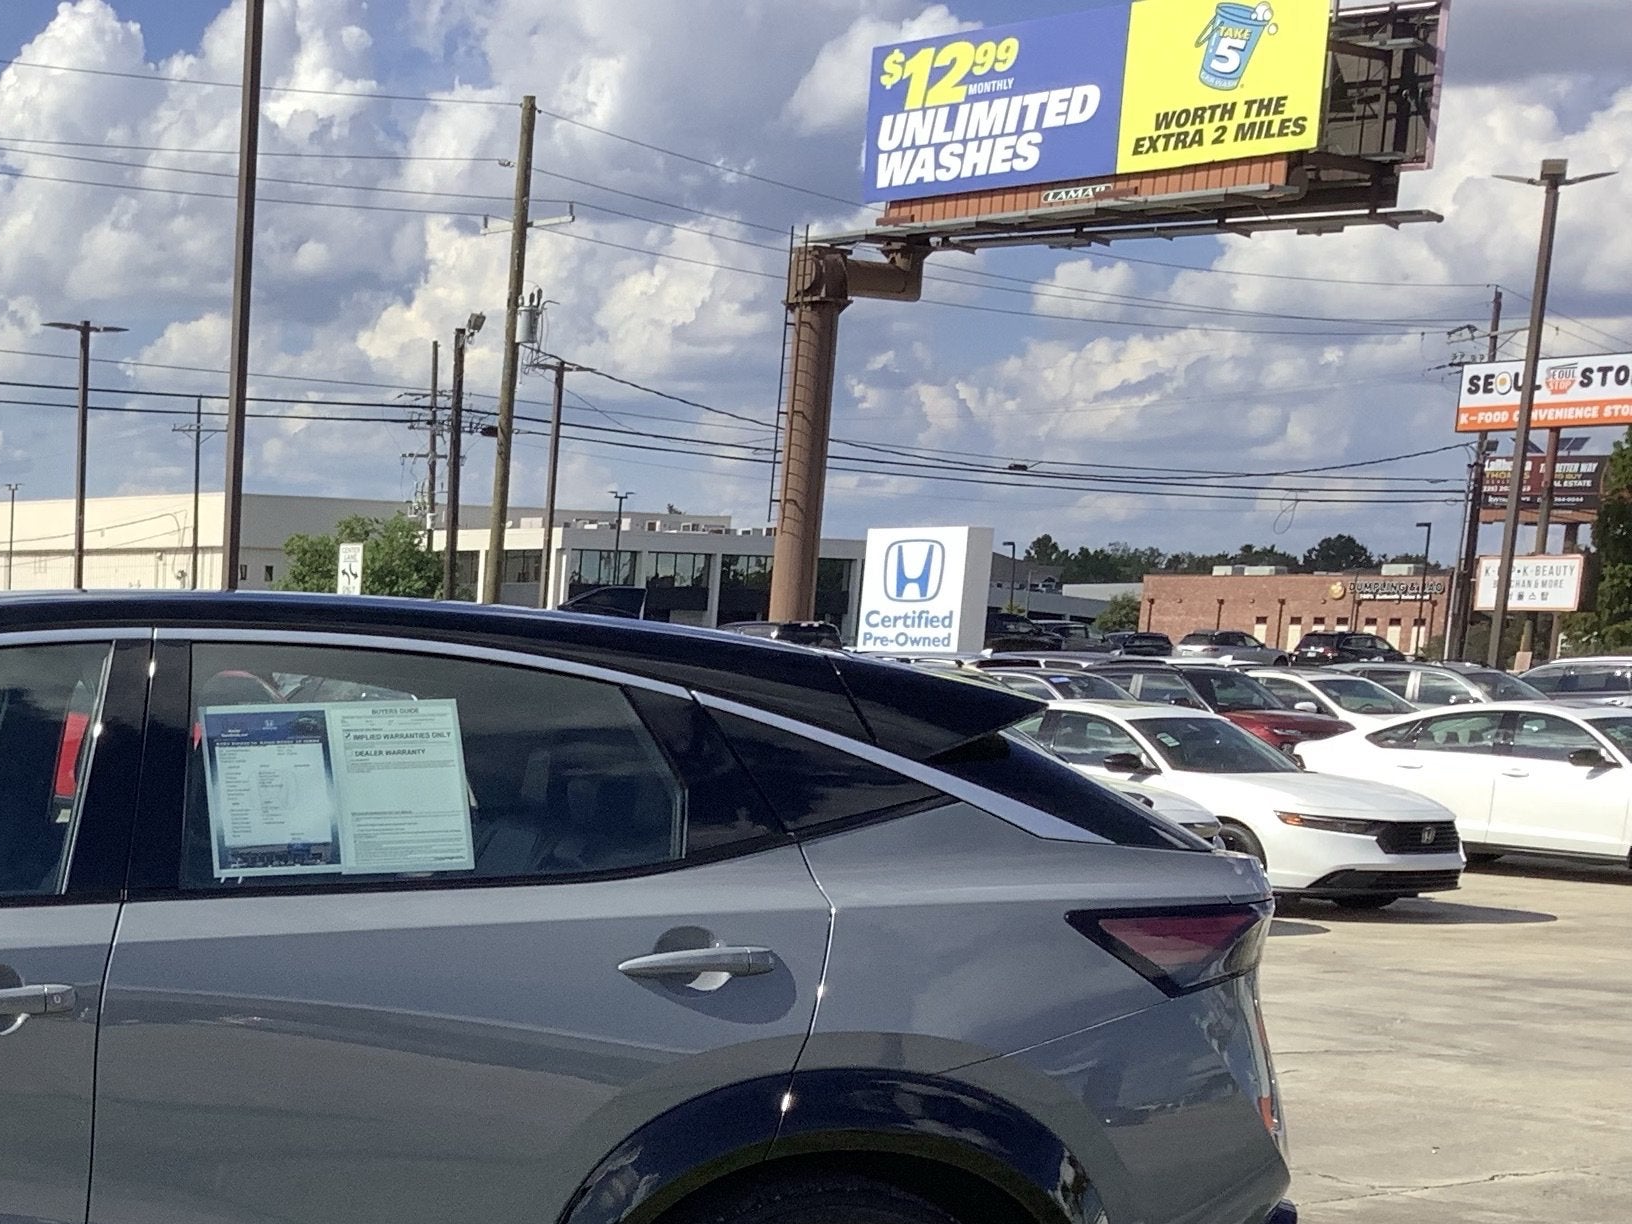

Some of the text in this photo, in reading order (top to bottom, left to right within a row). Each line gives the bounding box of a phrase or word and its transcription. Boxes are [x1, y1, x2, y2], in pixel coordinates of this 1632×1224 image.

[1218, 26, 1252, 41] TAKE
[1210, 37, 1247, 73] 5
[968, 77, 1014, 96] MONTHLY
[877, 84, 1101, 152] UNLIMITED
[1154, 95, 1288, 131] WORTH THE
[1132, 116, 1308, 156] EXTRA 2 MILES
[876, 131, 1043, 189] WASHES
[1467, 371, 1542, 395] SEOU
[1579, 365, 1632, 388] STO
[1460, 404, 1632, 425] K-FOOD CNVENIENCE STO
[1486, 472, 1530, 480] THOS
[1563, 480, 1592, 488] ESTATE
[1349, 583, 1406, 592] DUMPLING
[1493, 579, 1532, 589] BCHAN
[1541, 579, 1564, 588] MORE
[865, 610, 954, 628] Certified
[863, 632, 951, 647] Pre-Owned
[383, 732, 430, 740] WARRANTIES
[432, 731, 451, 739] ONLY
[385, 748, 426, 756] WARRANTY
